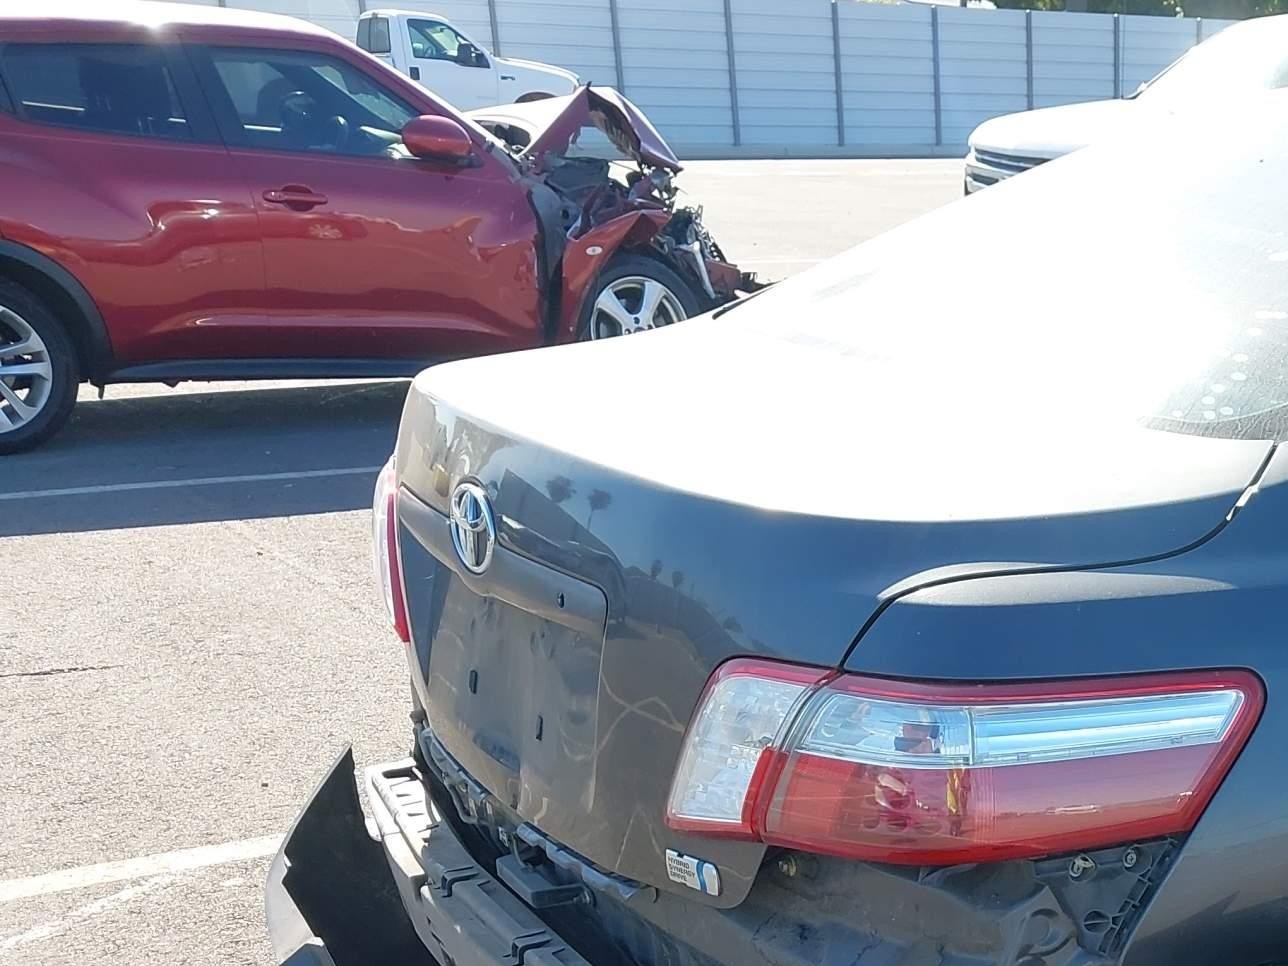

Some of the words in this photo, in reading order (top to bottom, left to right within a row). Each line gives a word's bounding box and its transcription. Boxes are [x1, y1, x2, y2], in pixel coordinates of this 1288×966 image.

[668, 855, 690, 869] HYBRID
[669, 864, 695, 878] SYNERGY
[670, 871, 688, 882] DRIVE
